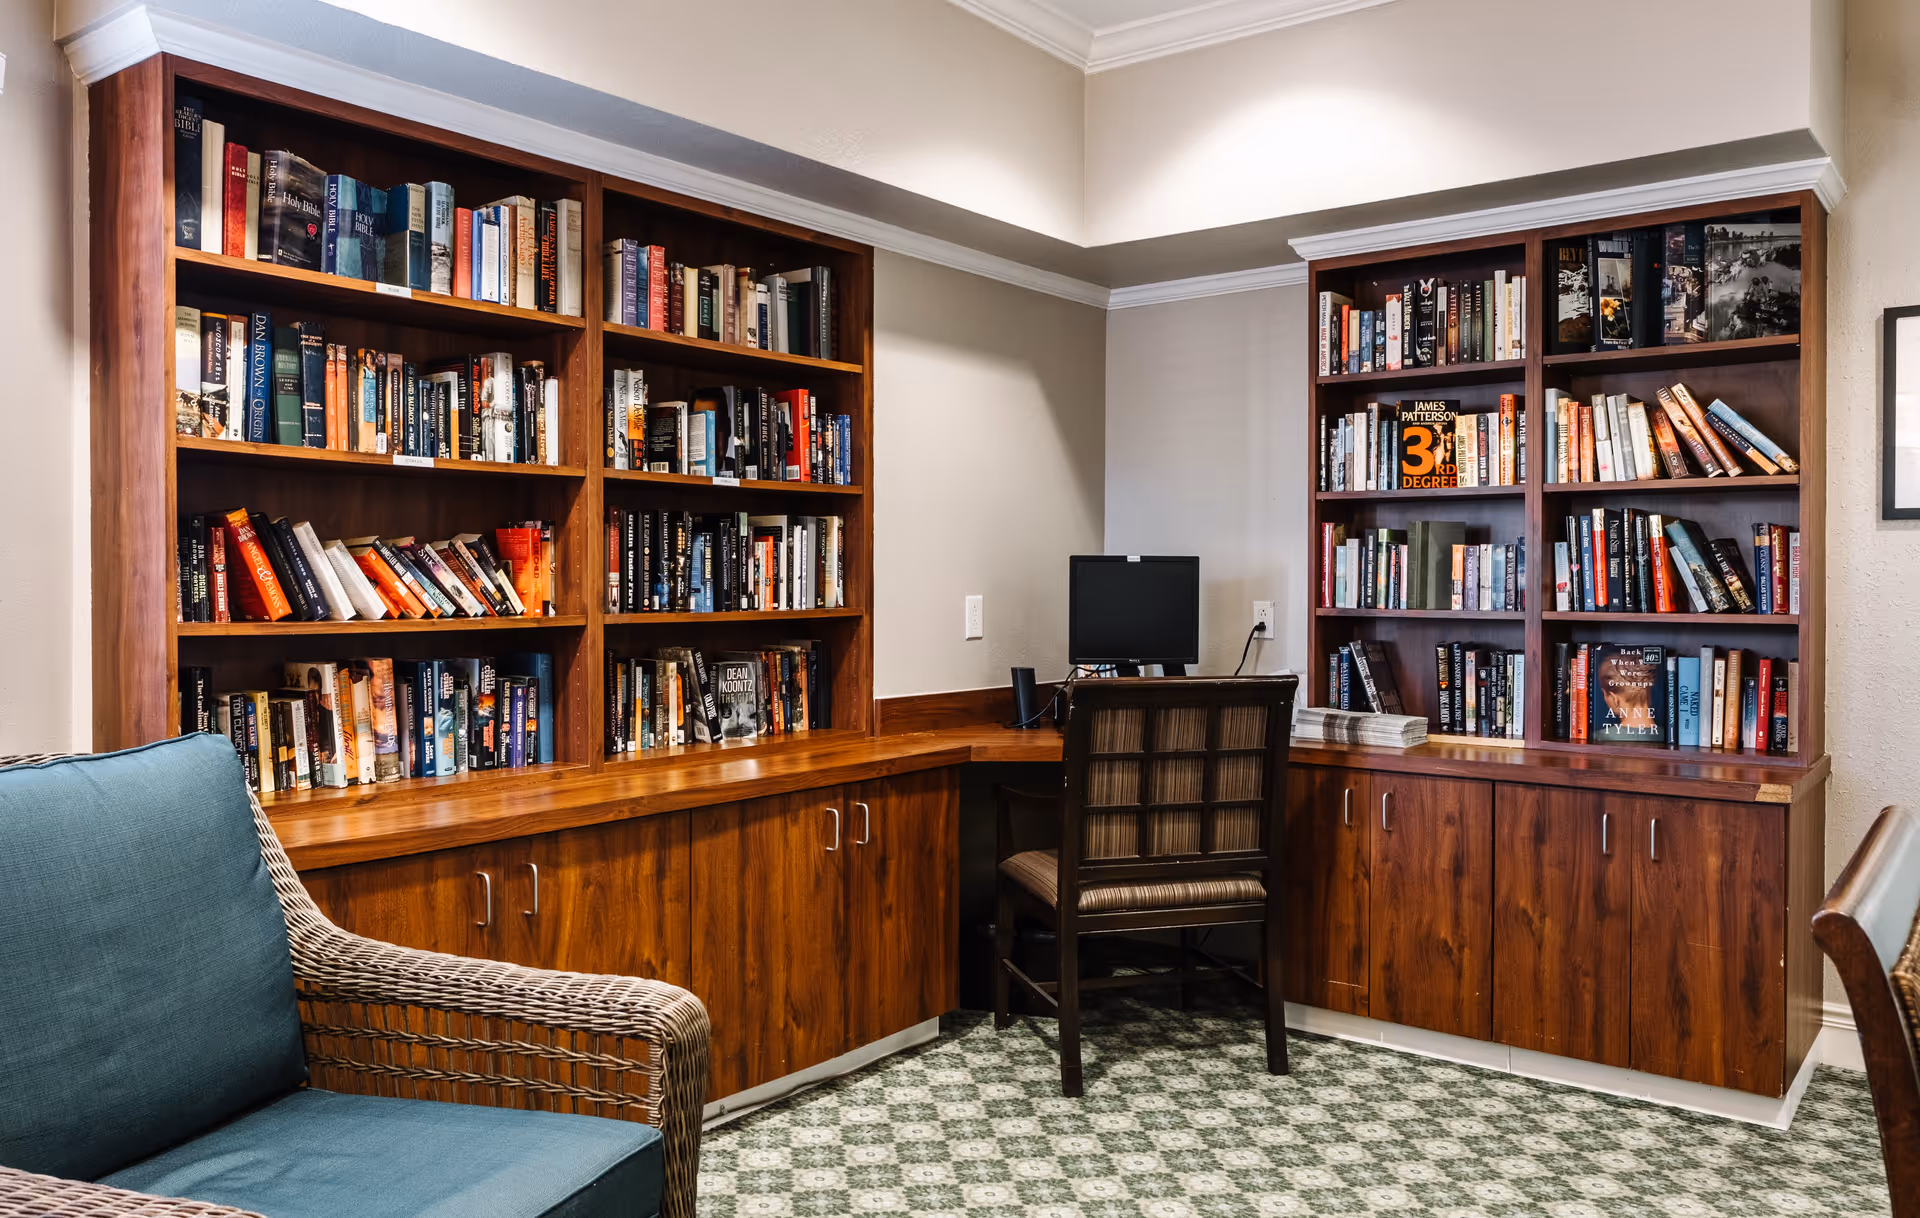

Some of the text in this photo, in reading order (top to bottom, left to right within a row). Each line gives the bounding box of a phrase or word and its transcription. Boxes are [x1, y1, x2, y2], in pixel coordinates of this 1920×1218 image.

[232, 171, 246, 179] BIBLE
[267, 160, 277, 203] Holy Bible
[282, 192, 321, 218] Holy Bible
[328, 183, 337, 233] HOLY BIBLE
[355, 212, 374, 226] HOLY
[355, 222, 374, 236] BIBLE
[519, 214, 528, 266] Archipelago
[278, 362, 296, 370] HISTORY
[252, 314, 266, 438] DAN BROWN ORIGIN
[634, 377, 642, 400] Nelson
[1415, 401, 1445, 411] JAMES
[634, 403, 644, 430] DeMille
[1402, 412, 1458, 421] PATTERSON
[472, 417, 480, 452] Silent Man
[1402, 426, 1457, 476] 3RD
[1458, 435, 1466, 474] JAMES PATTERSON
[1403, 476, 1458, 488] DEGREE
[238, 531, 256, 543] BROWN
[239, 526, 251, 535] DAN
[1610, 520, 1619, 554] DANIELLE STEEL
[380, 546, 391, 560] JAMES
[417, 549, 435, 568] SILK
[247, 541, 282, 608] ANGELS & DEMONS
[727, 668, 747, 680] DEAN
[1454, 663, 1462, 687] SANDFORD
[722, 680, 752, 693] KOONTZ
[1608, 680, 1653, 688] Grownups
[721, 693, 754, 703] THE CITY
[1680, 686, 1688, 705] CAME
[704, 694, 717, 720] COLD FIRE
[1440, 691, 1450, 723] DARK MOON
[1605, 707, 1656, 718] ANNE
[233, 697, 242, 751] TOM CLANCY
[1602, 724, 1659, 735] TYLER
[384, 723, 395, 748] LANDS
